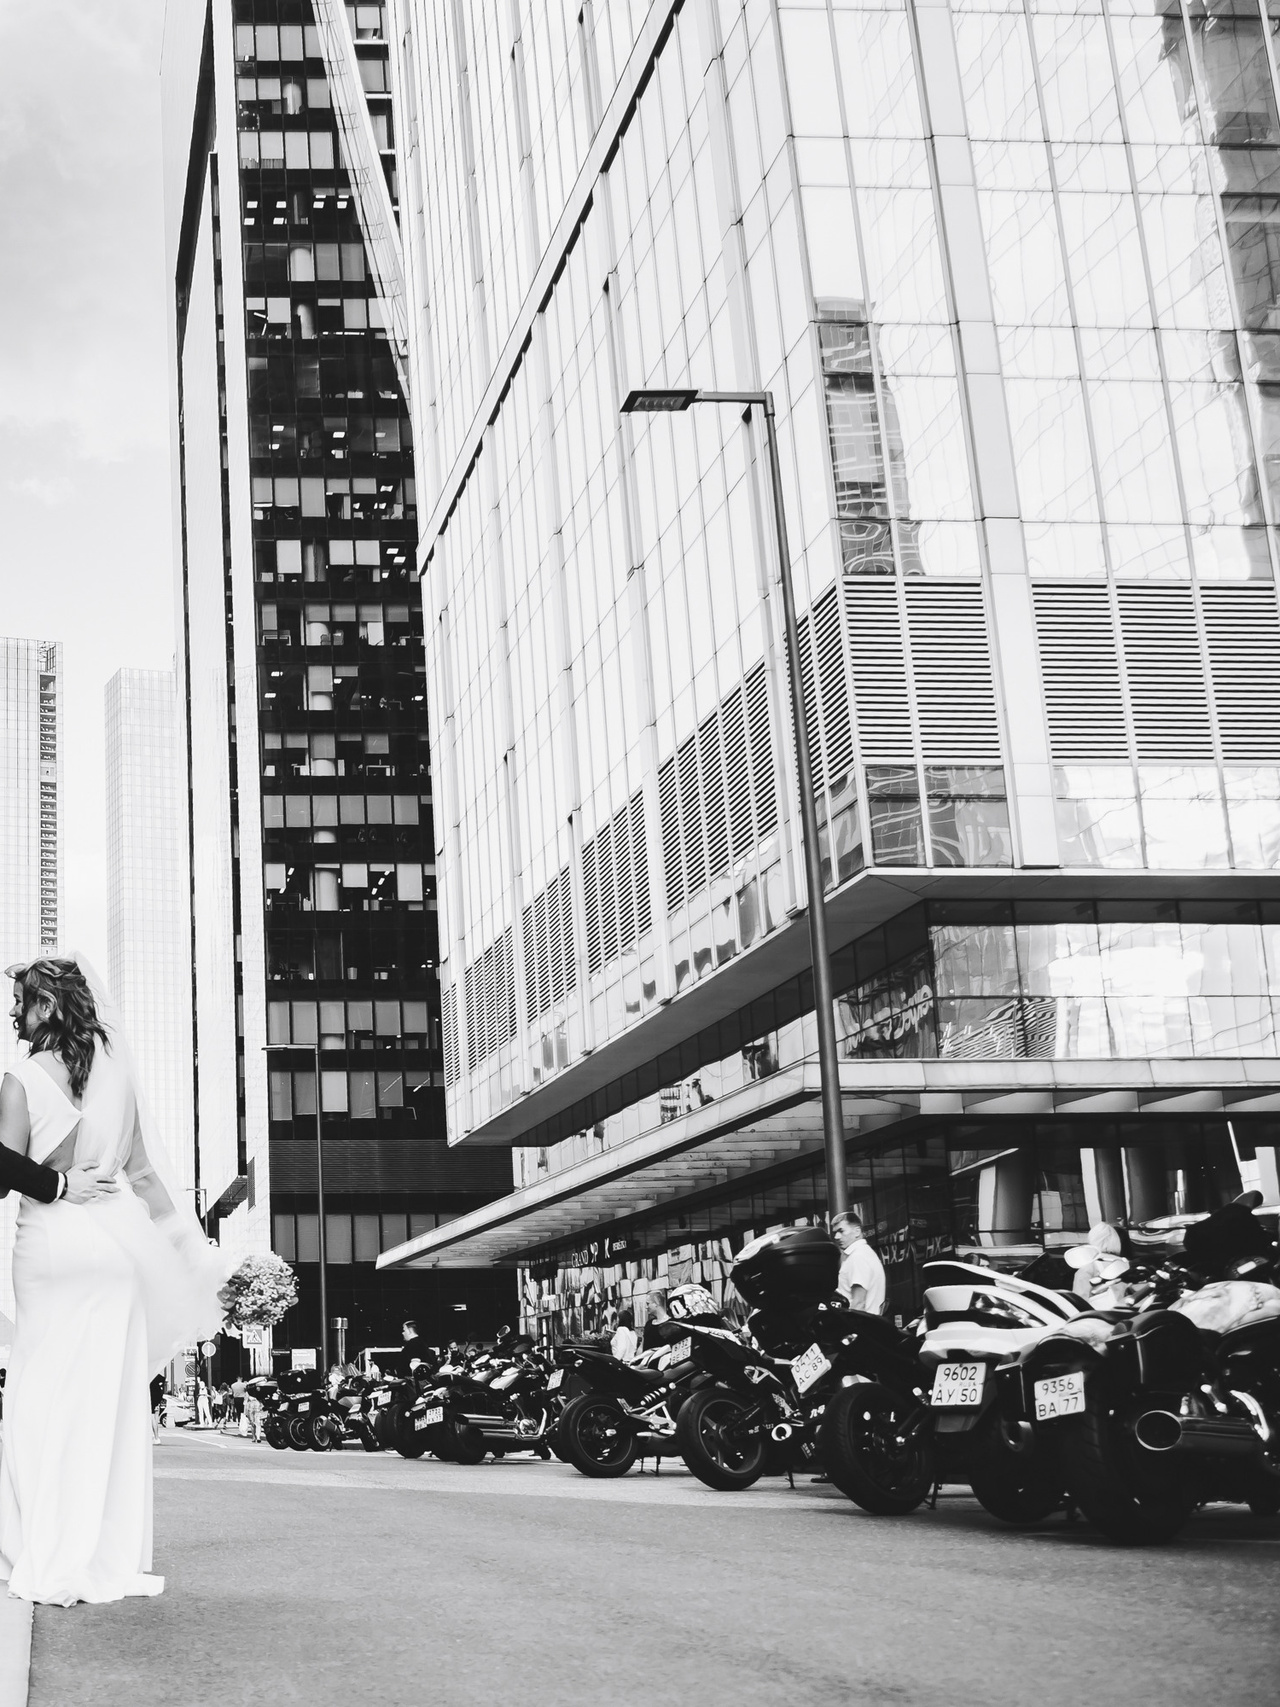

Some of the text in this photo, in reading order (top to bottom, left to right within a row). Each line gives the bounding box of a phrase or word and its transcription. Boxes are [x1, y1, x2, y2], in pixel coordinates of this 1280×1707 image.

[794, 1347, 816, 1373] 0411
[943, 1366, 978, 1381] 9602
[1042, 1378, 1075, 1395] 9356
[960, 1388, 978, 1402] 50
[1064, 1397, 1079, 1412] 77
